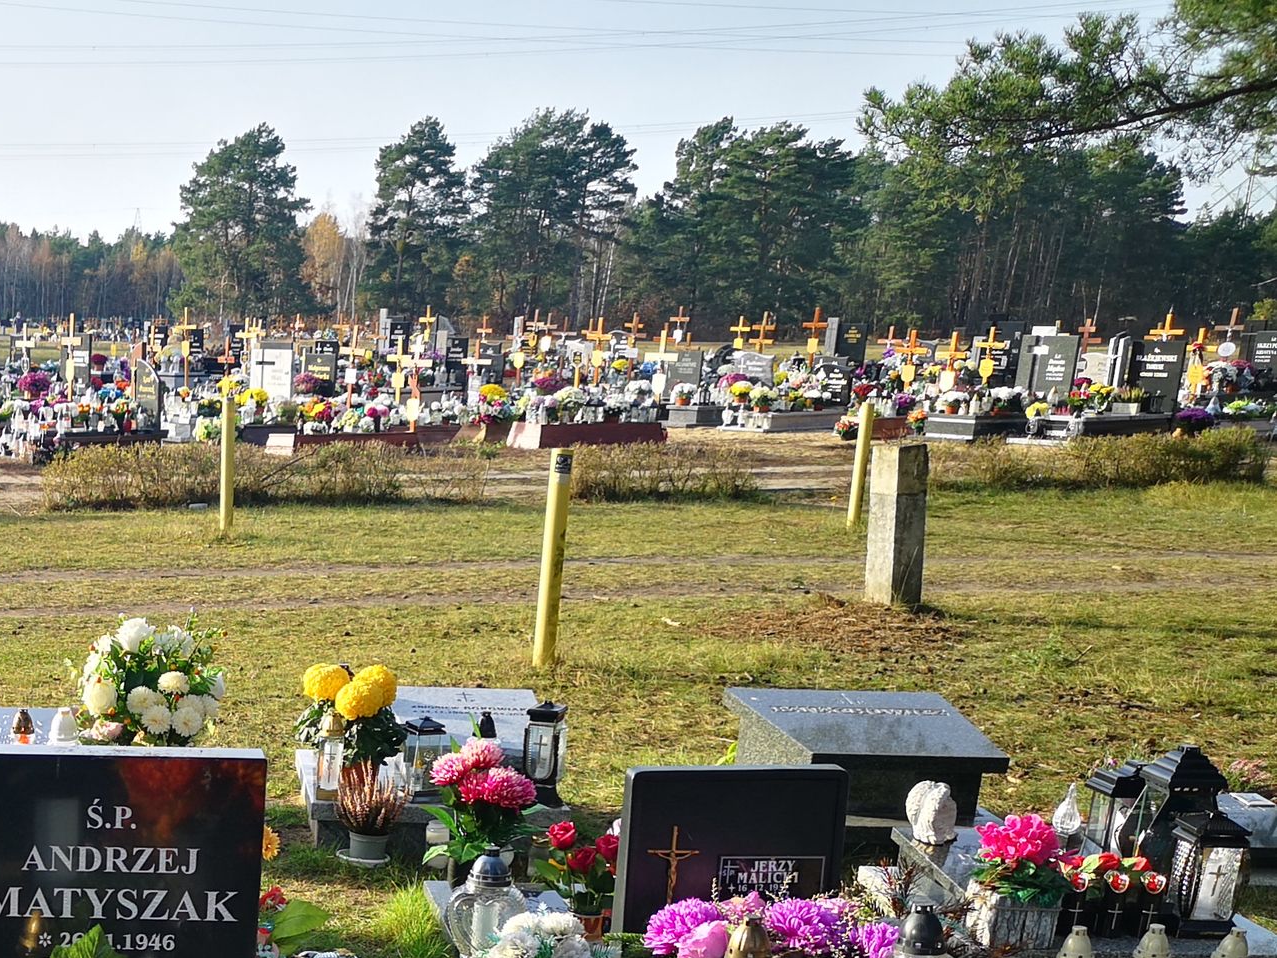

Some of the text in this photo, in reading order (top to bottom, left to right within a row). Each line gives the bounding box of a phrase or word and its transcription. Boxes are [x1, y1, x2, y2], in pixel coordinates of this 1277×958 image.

[86, 798, 137, 830] Ś.P.
[21, 845, 200, 876] ANDRZEJ
[750, 860, 796, 872] JERZY
